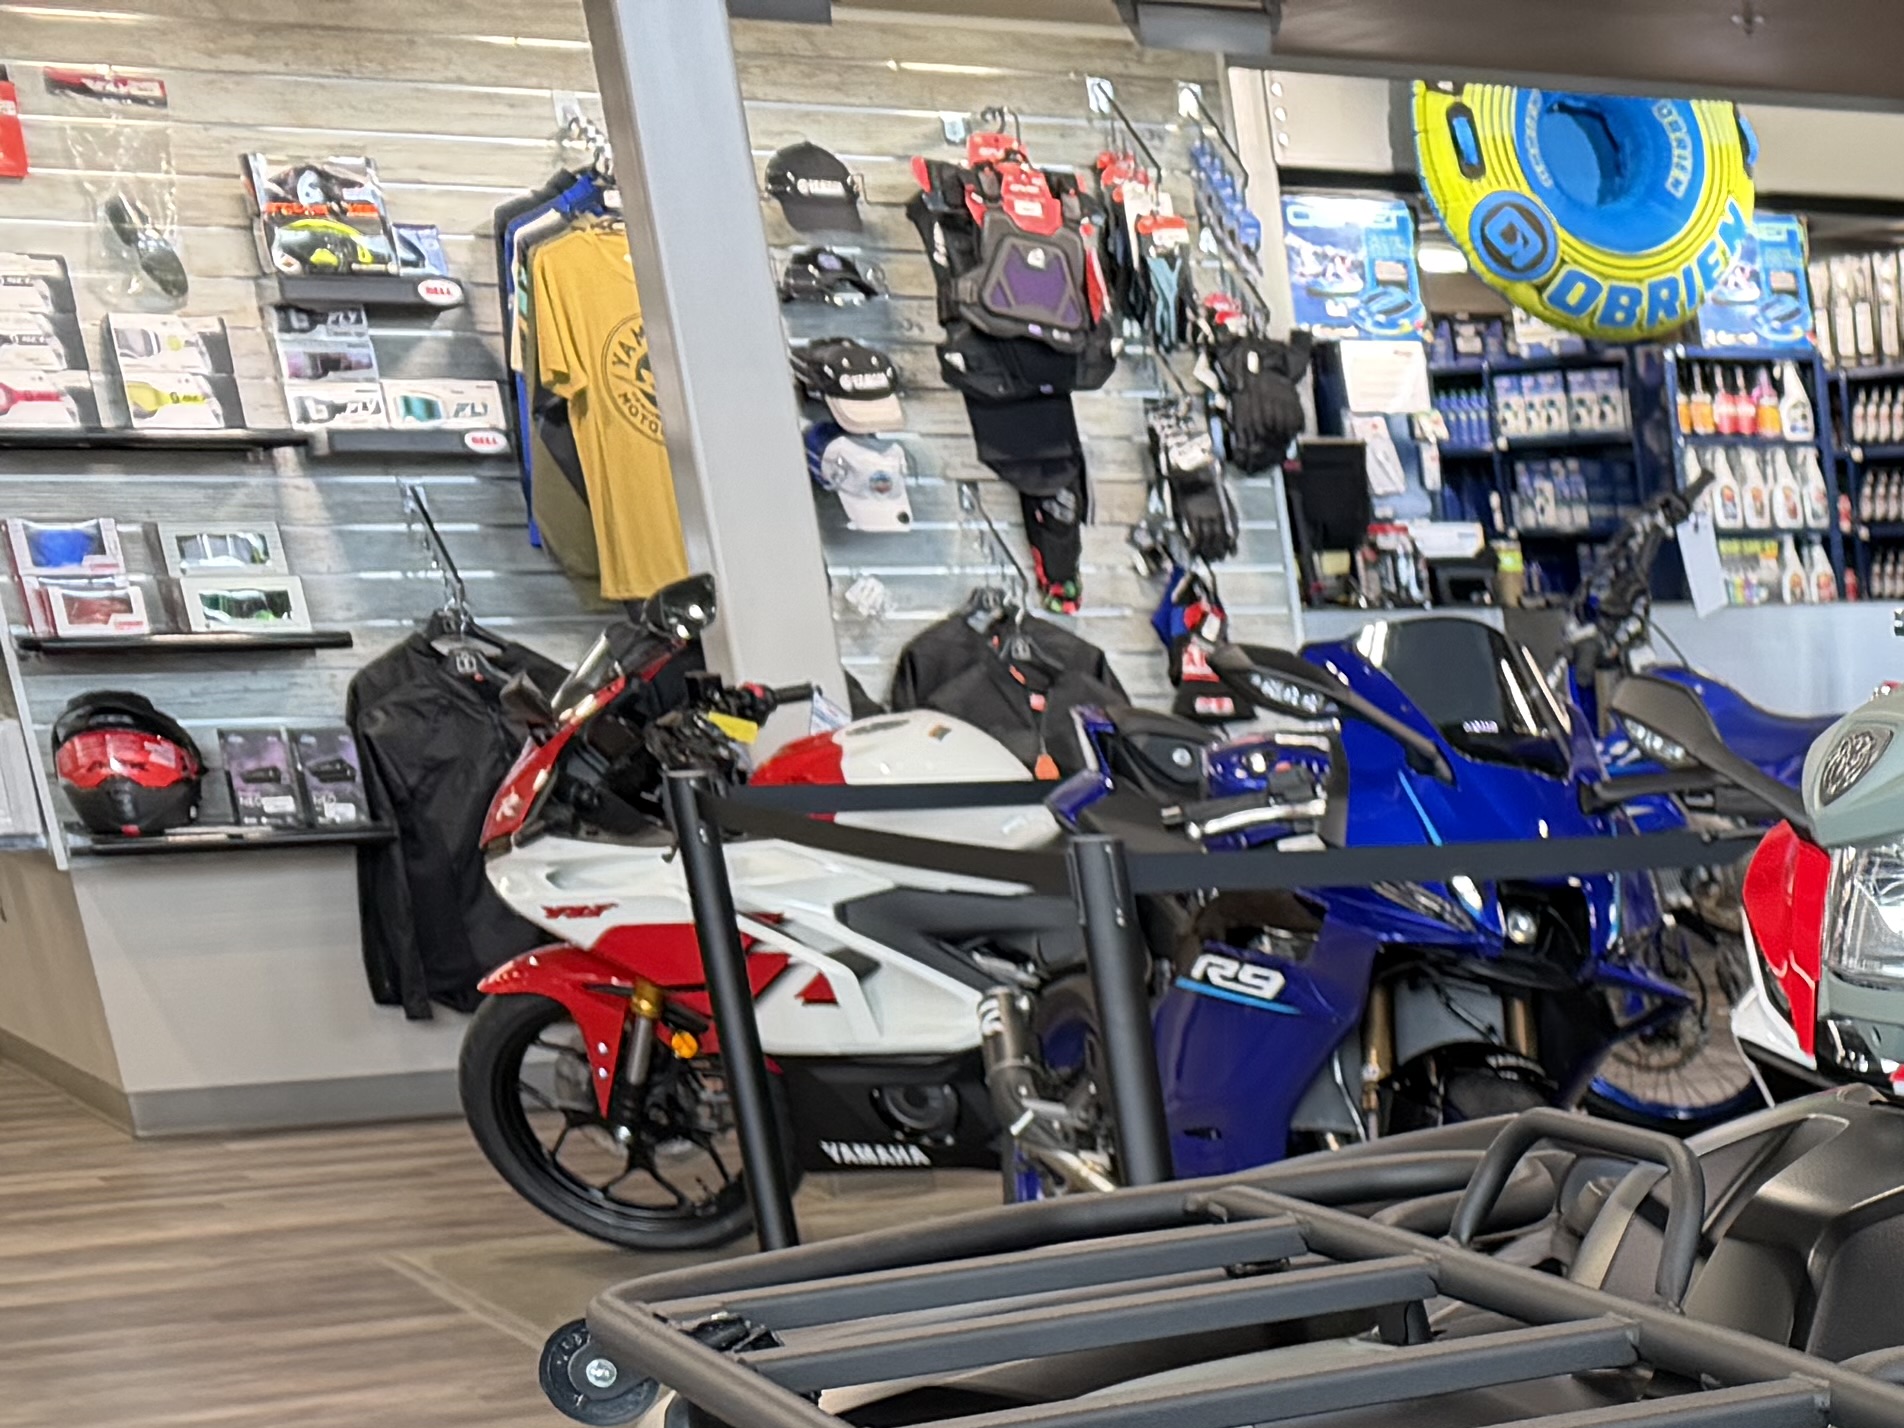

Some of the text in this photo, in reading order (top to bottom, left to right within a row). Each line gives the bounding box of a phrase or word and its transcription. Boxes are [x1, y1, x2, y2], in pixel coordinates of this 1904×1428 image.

[1546, 196, 1748, 328] OBRIEN
[612, 324, 646, 369] YAM
[1192, 953, 1286, 1000] R9
[820, 1140, 933, 1167] YAMAHA
